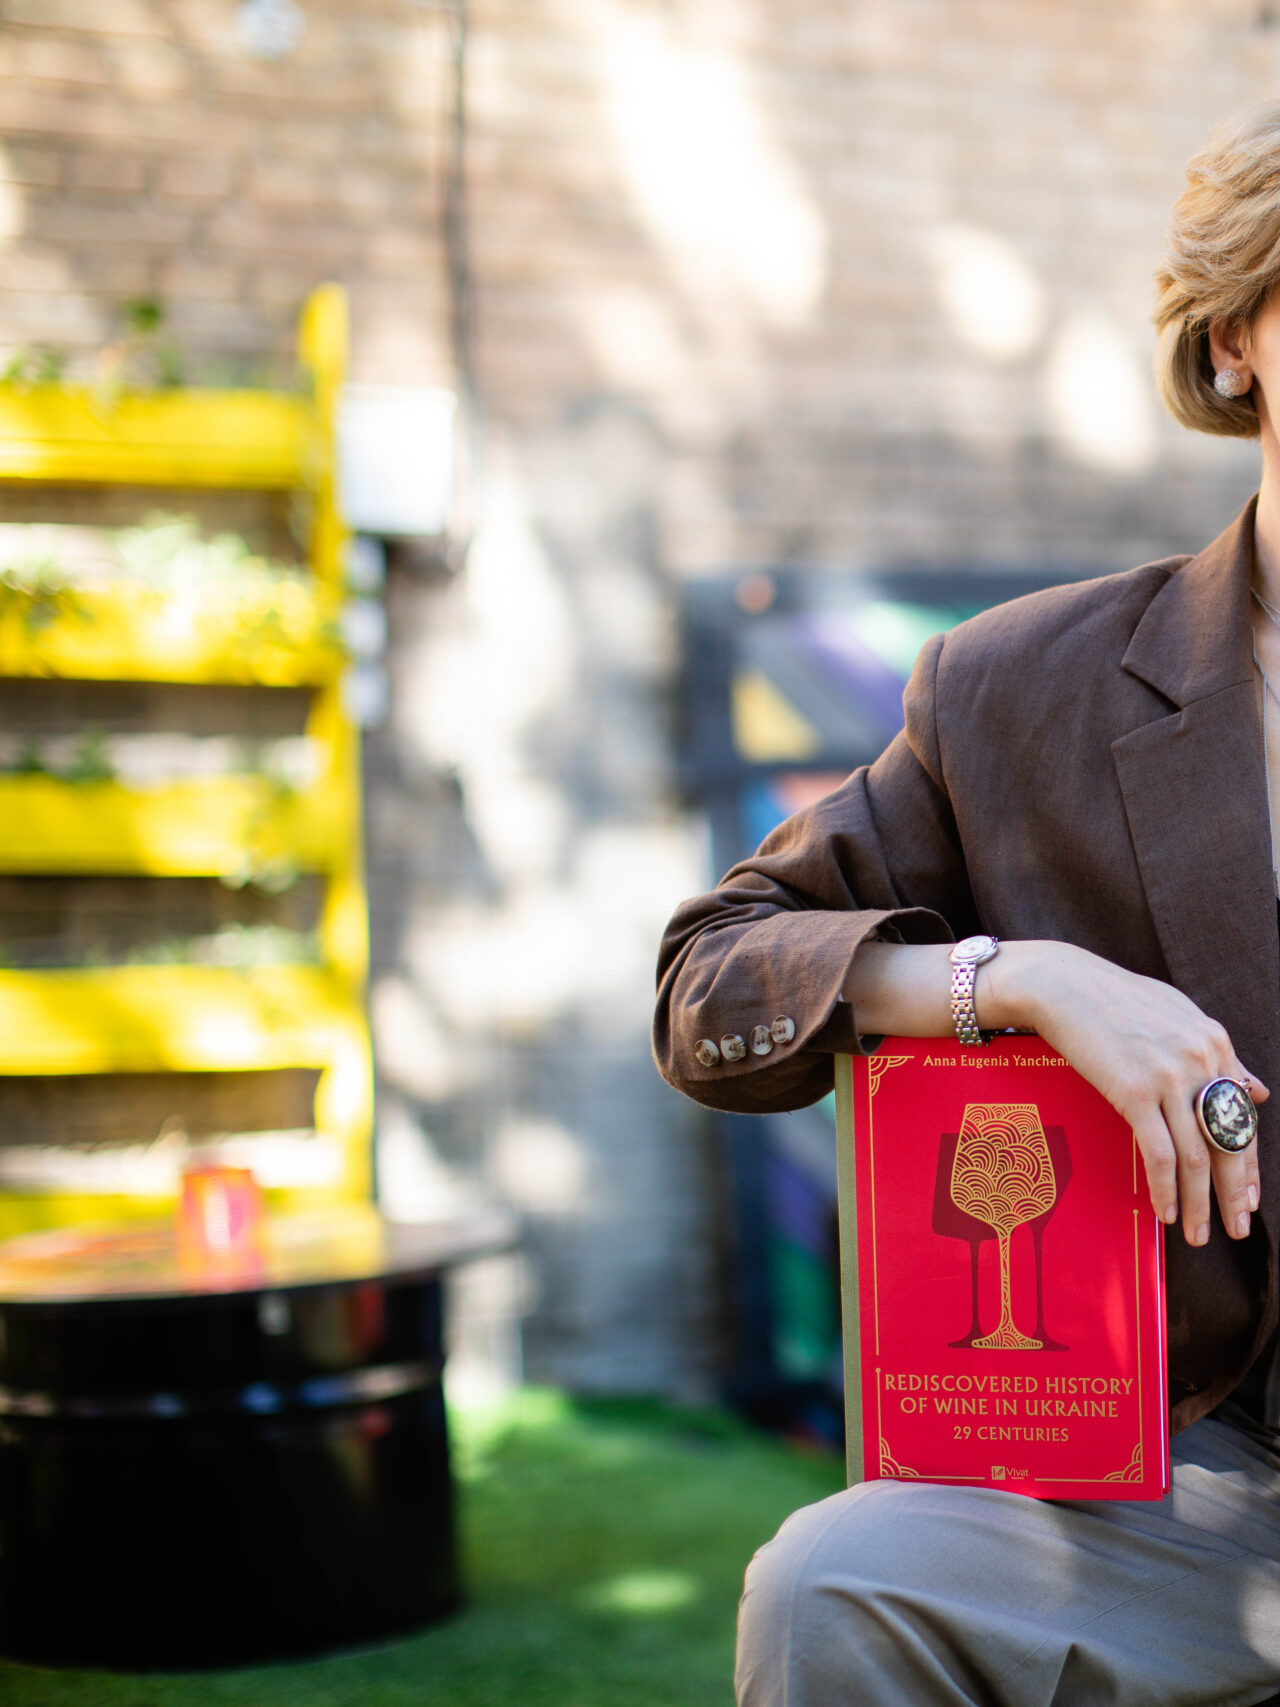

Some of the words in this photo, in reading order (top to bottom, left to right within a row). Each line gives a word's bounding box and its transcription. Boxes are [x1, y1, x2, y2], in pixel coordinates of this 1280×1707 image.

[923, 1054, 957, 1067] Anna
[960, 1054, 1009, 1069] Eugenia
[884, 1373, 1039, 1393] REDISCOVERED
[1045, 1377, 1134, 1395] HISTORY
[900, 1396, 928, 1414] OF
[933, 1397, 989, 1415] WINE
[995, 1399, 1018, 1416] IN
[1025, 1399, 1119, 1418] UKRAINE
[953, 1425, 972, 1440] 29
[977, 1426, 1069, 1442] CENTURIES
[1006, 1466, 1029, 1477] Vivat
